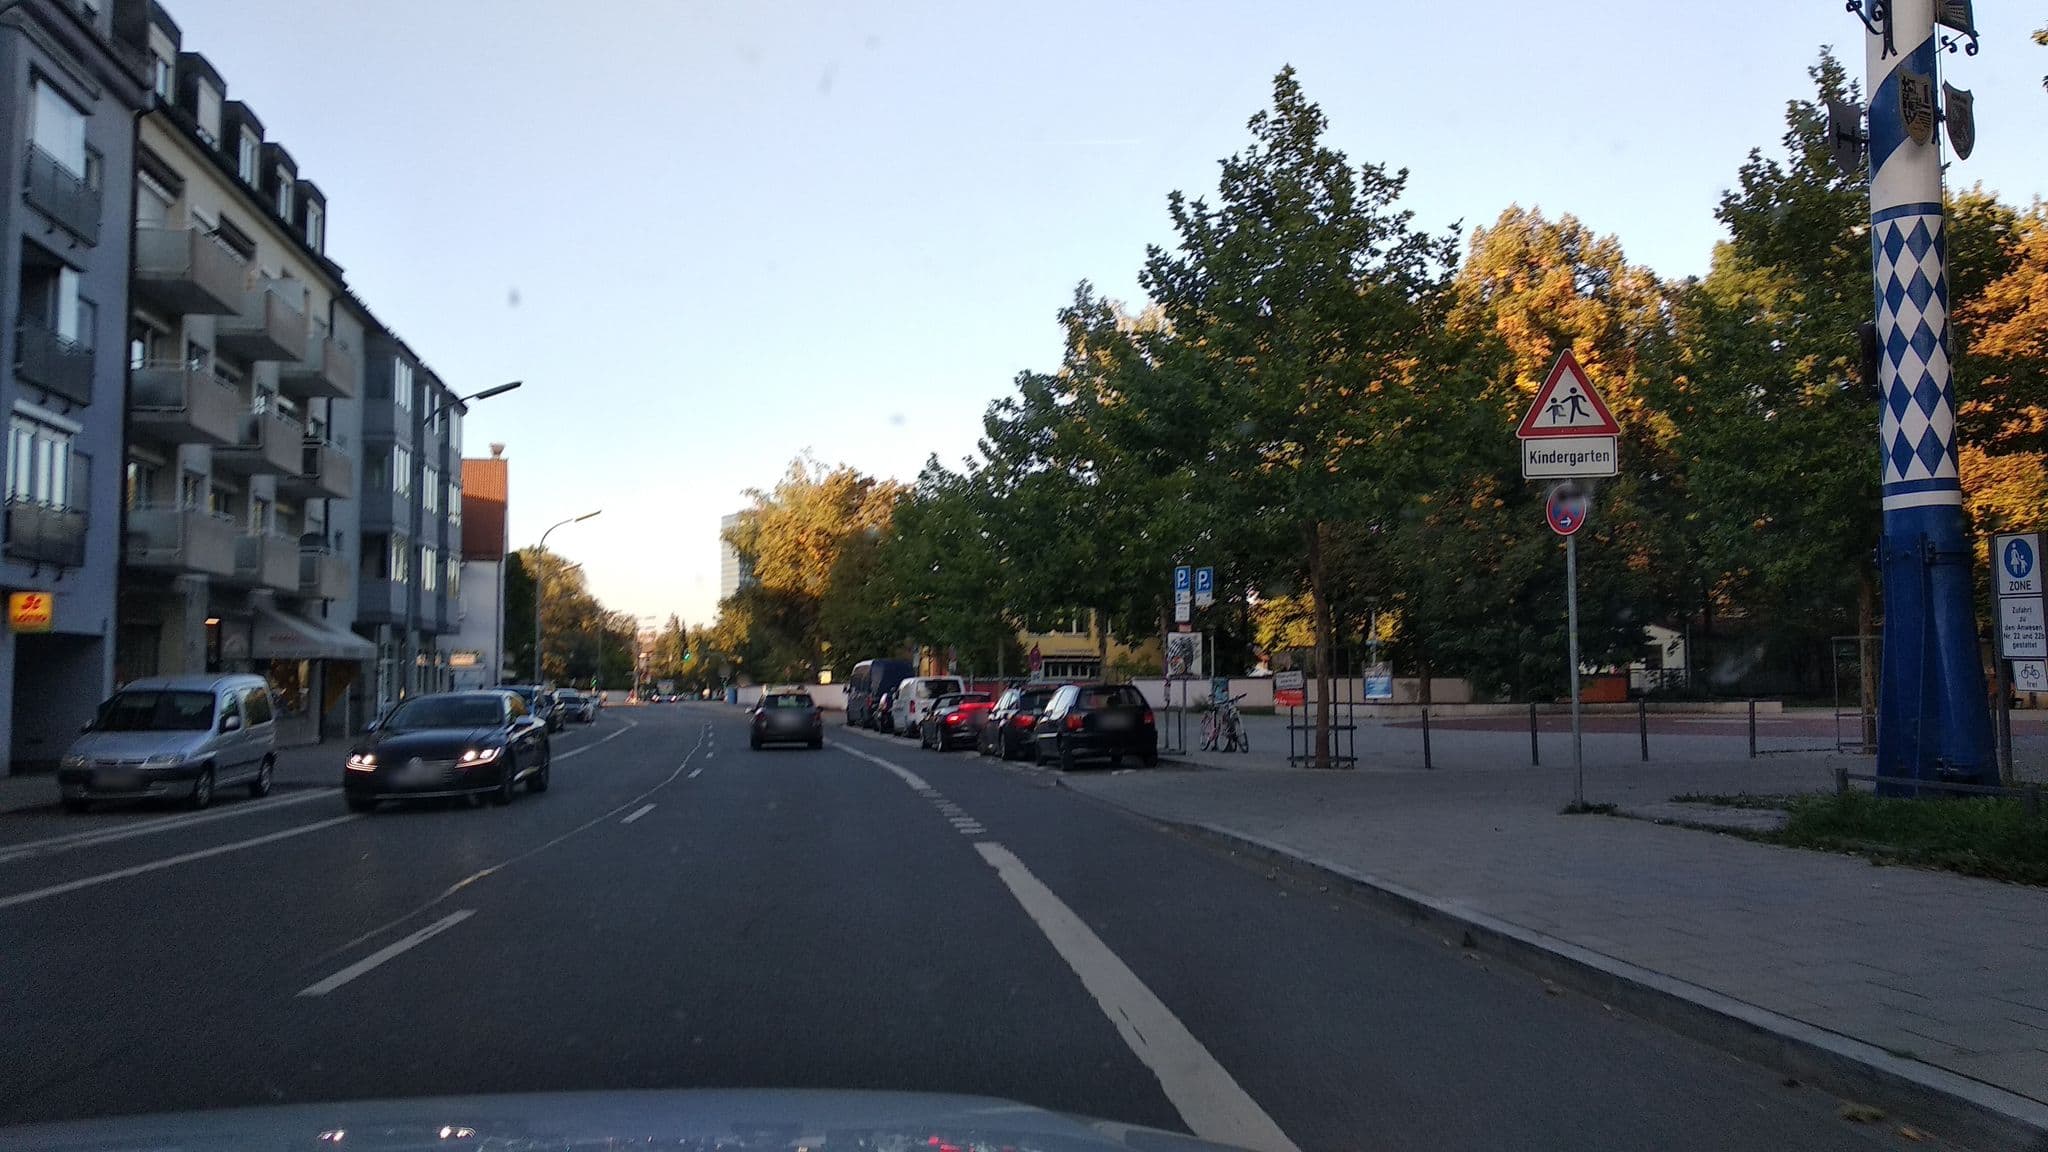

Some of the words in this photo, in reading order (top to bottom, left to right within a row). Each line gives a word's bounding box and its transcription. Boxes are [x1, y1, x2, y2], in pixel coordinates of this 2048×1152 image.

[1529, 450, 1610, 467] Kindergarten
[1177, 569, 1187, 588] P
[1198, 570, 1208, 589] P
[2009, 580, 2032, 591] ZONE
[2012, 606, 2032, 614] Zufahrt
